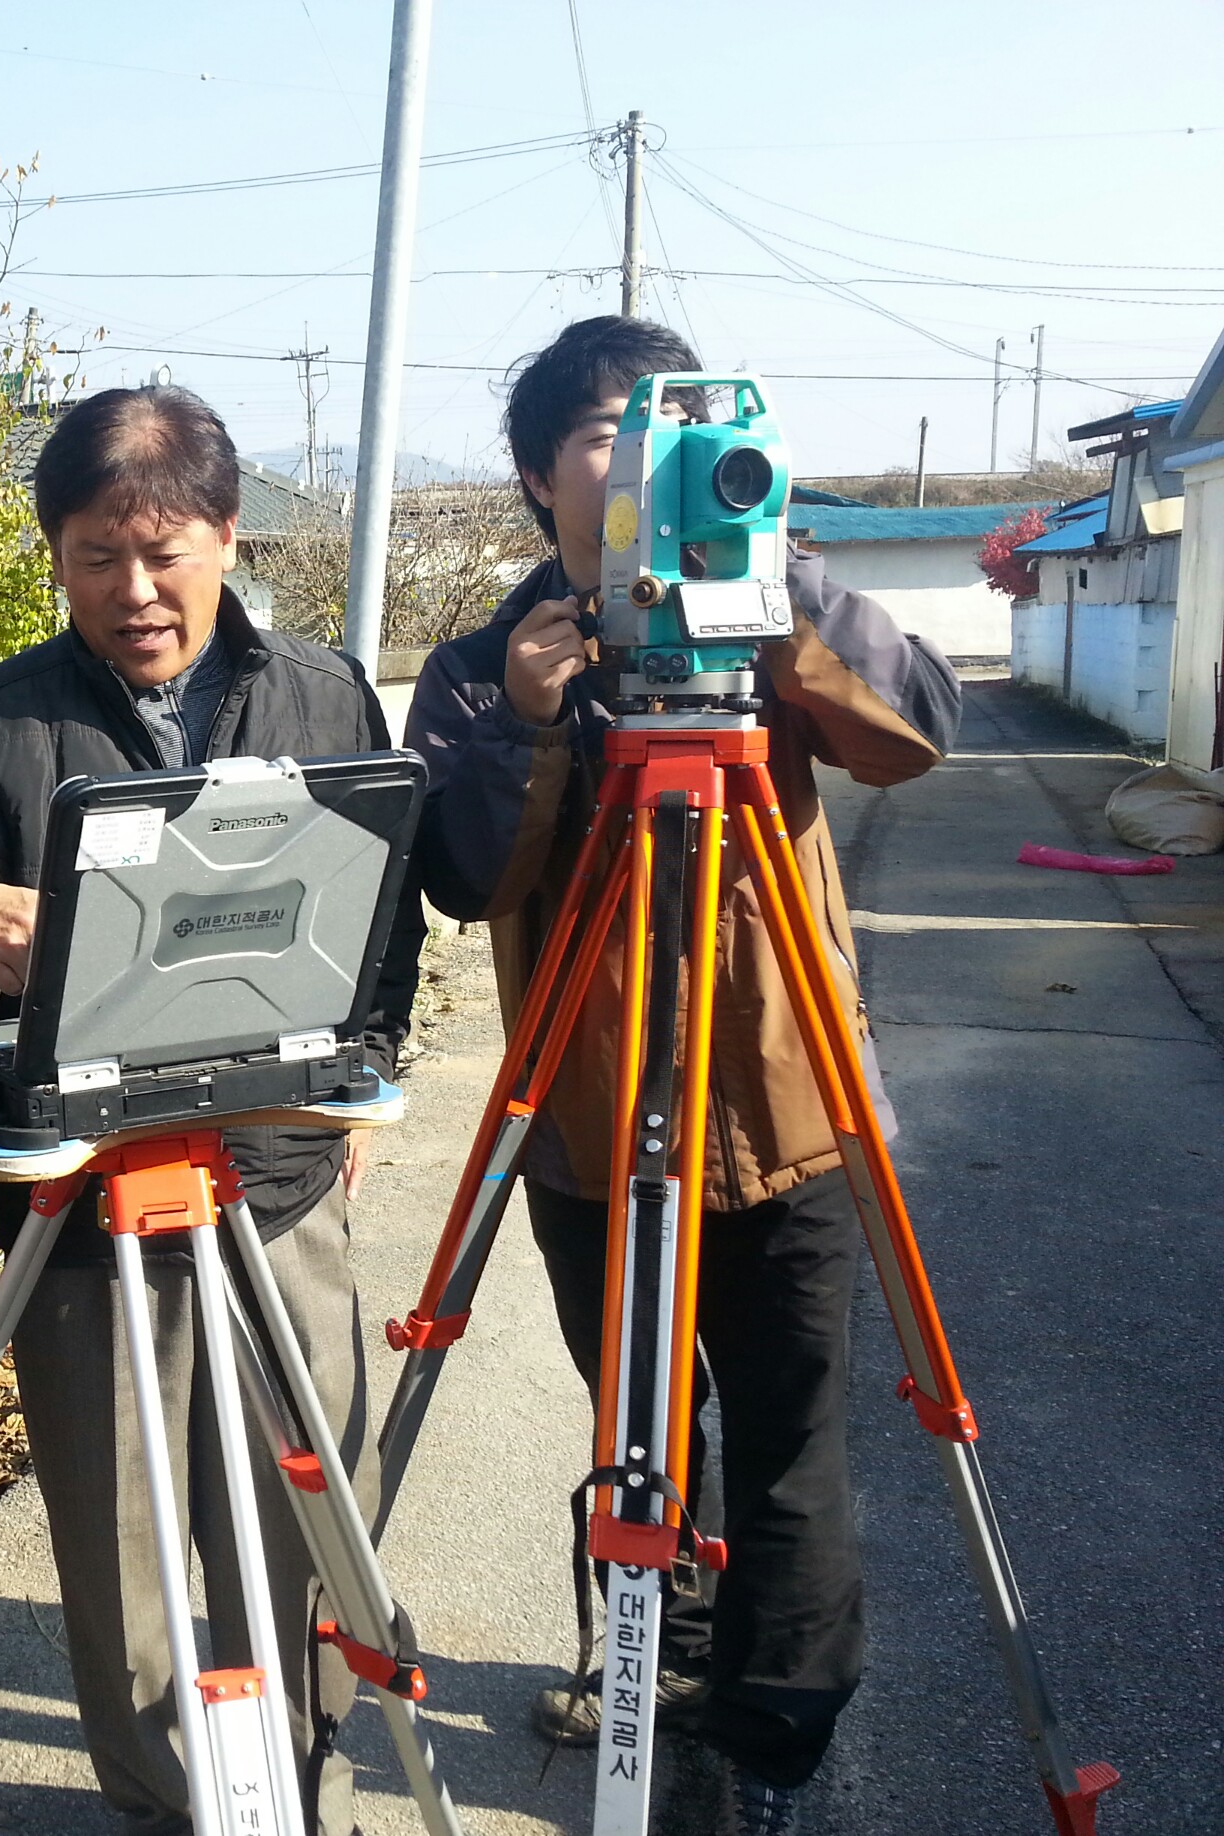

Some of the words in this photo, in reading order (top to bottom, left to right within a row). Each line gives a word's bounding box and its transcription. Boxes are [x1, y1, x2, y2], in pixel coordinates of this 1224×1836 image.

[208, 812, 288, 832] Panasonic
[197, 909, 285, 929] 대한지적공사
[609, 1592, 646, 1782] 대한지적공사
